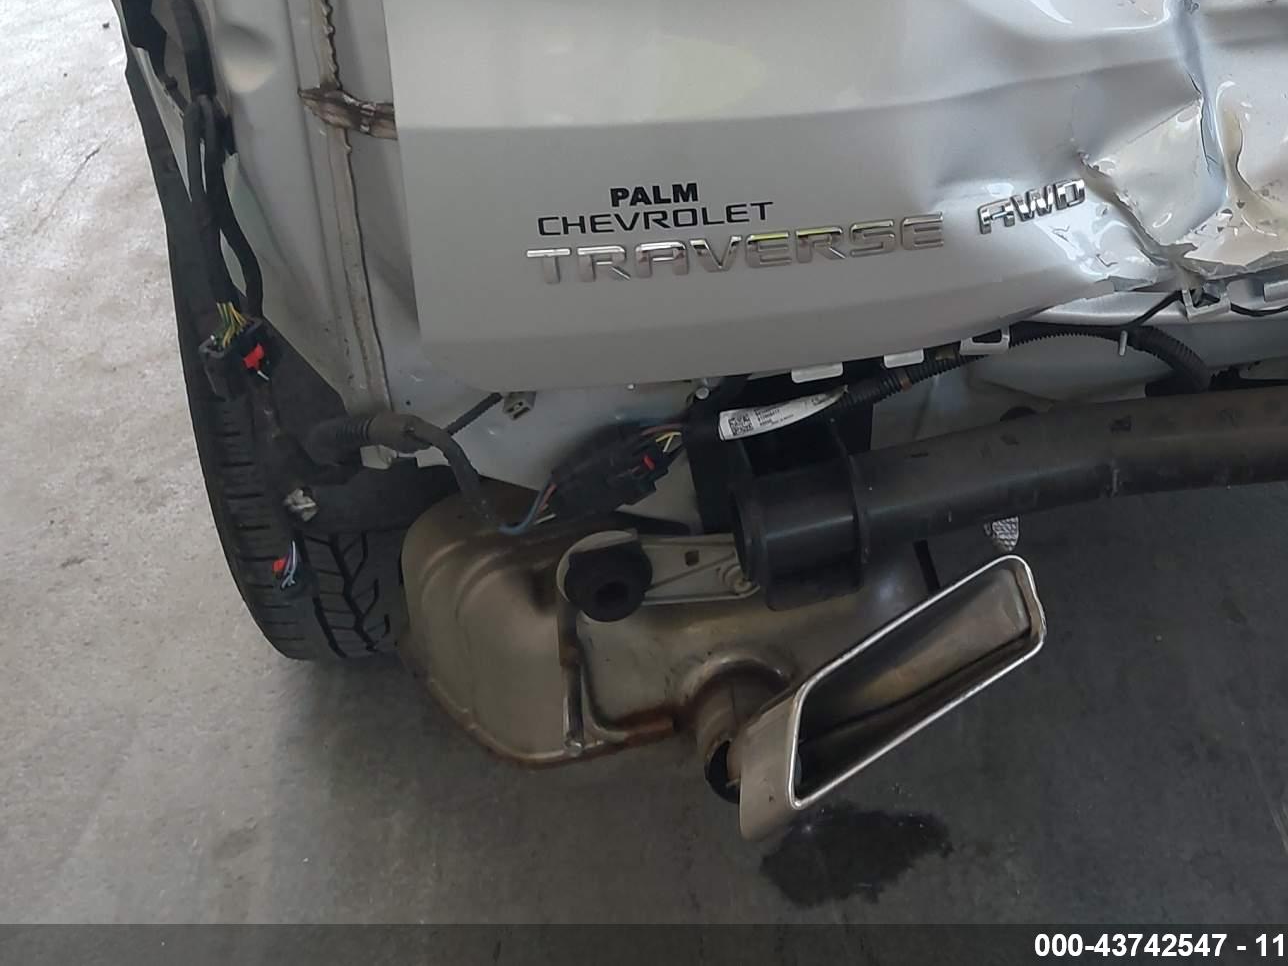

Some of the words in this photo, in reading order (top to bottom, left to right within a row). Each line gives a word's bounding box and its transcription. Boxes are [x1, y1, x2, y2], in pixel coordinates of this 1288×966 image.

[610, 183, 698, 206] PALM
[526, 212, 944, 284] TRAVERSE
[977, 178, 1086, 233] AWD
[538, 201, 773, 236] CHEVROLET
